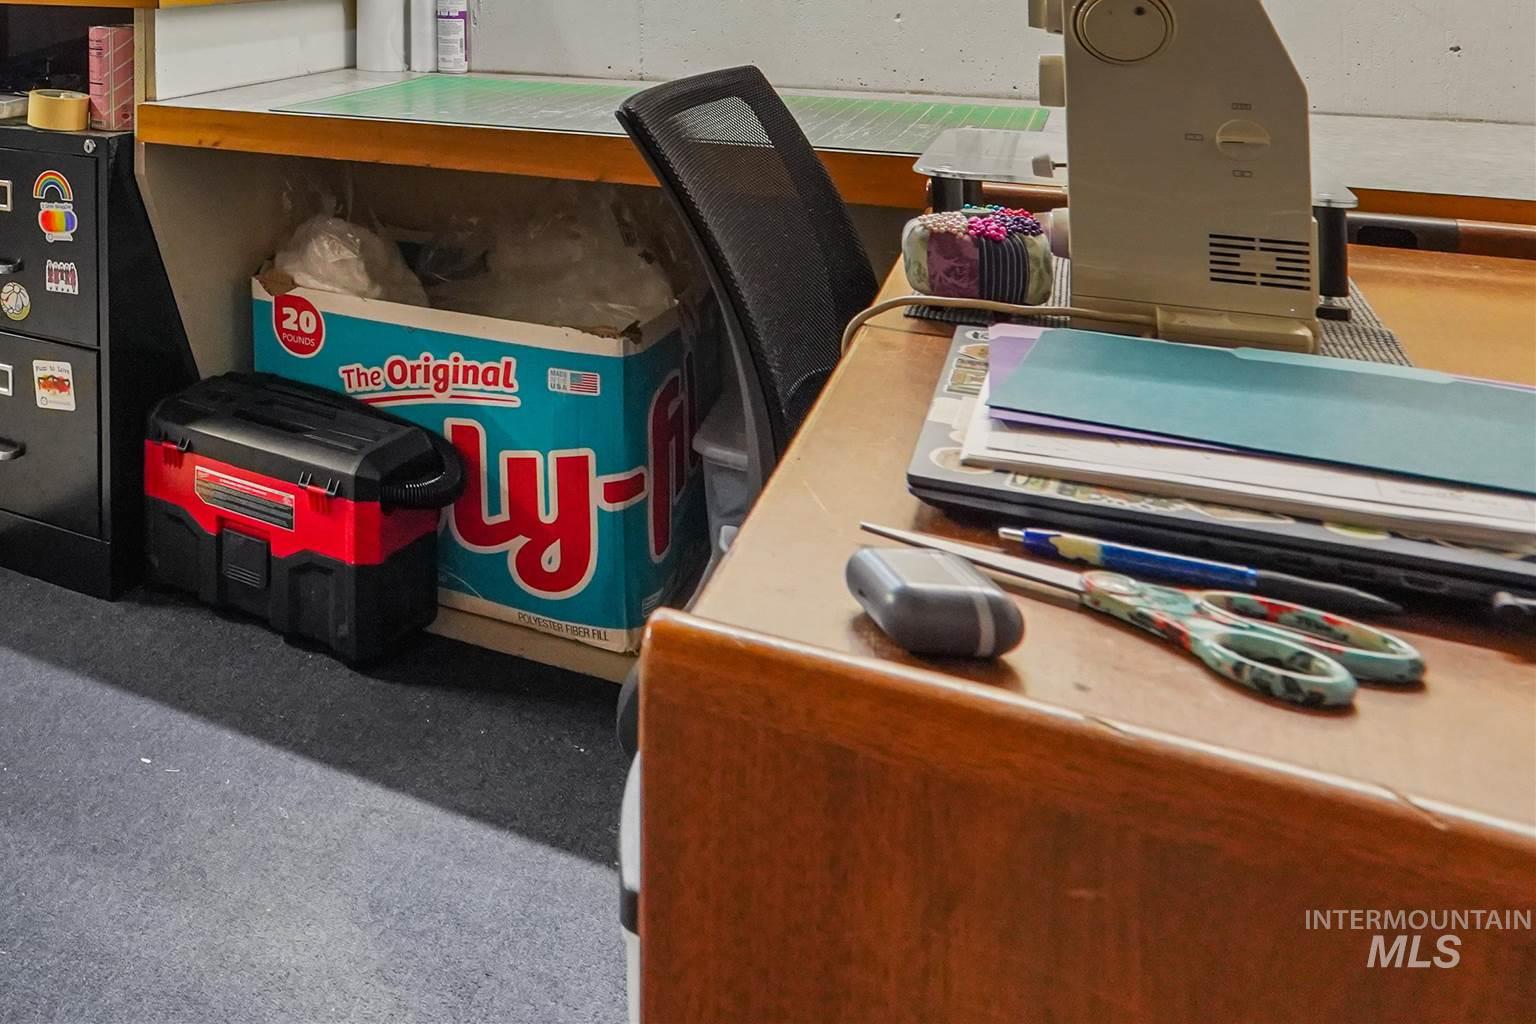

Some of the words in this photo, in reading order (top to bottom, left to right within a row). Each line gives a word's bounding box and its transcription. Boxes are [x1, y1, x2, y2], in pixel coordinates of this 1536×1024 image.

[282, 307, 317, 333] 20
[282, 332, 316, 347] POUNDS
[342, 368, 381, 389] The
[387, 356, 514, 393] Original
[550, 383, 568, 391] USA
[518, 611, 564, 633] POLYESTER
[565, 624, 591, 638] FIBER
[592, 629, 609, 641] FILL
